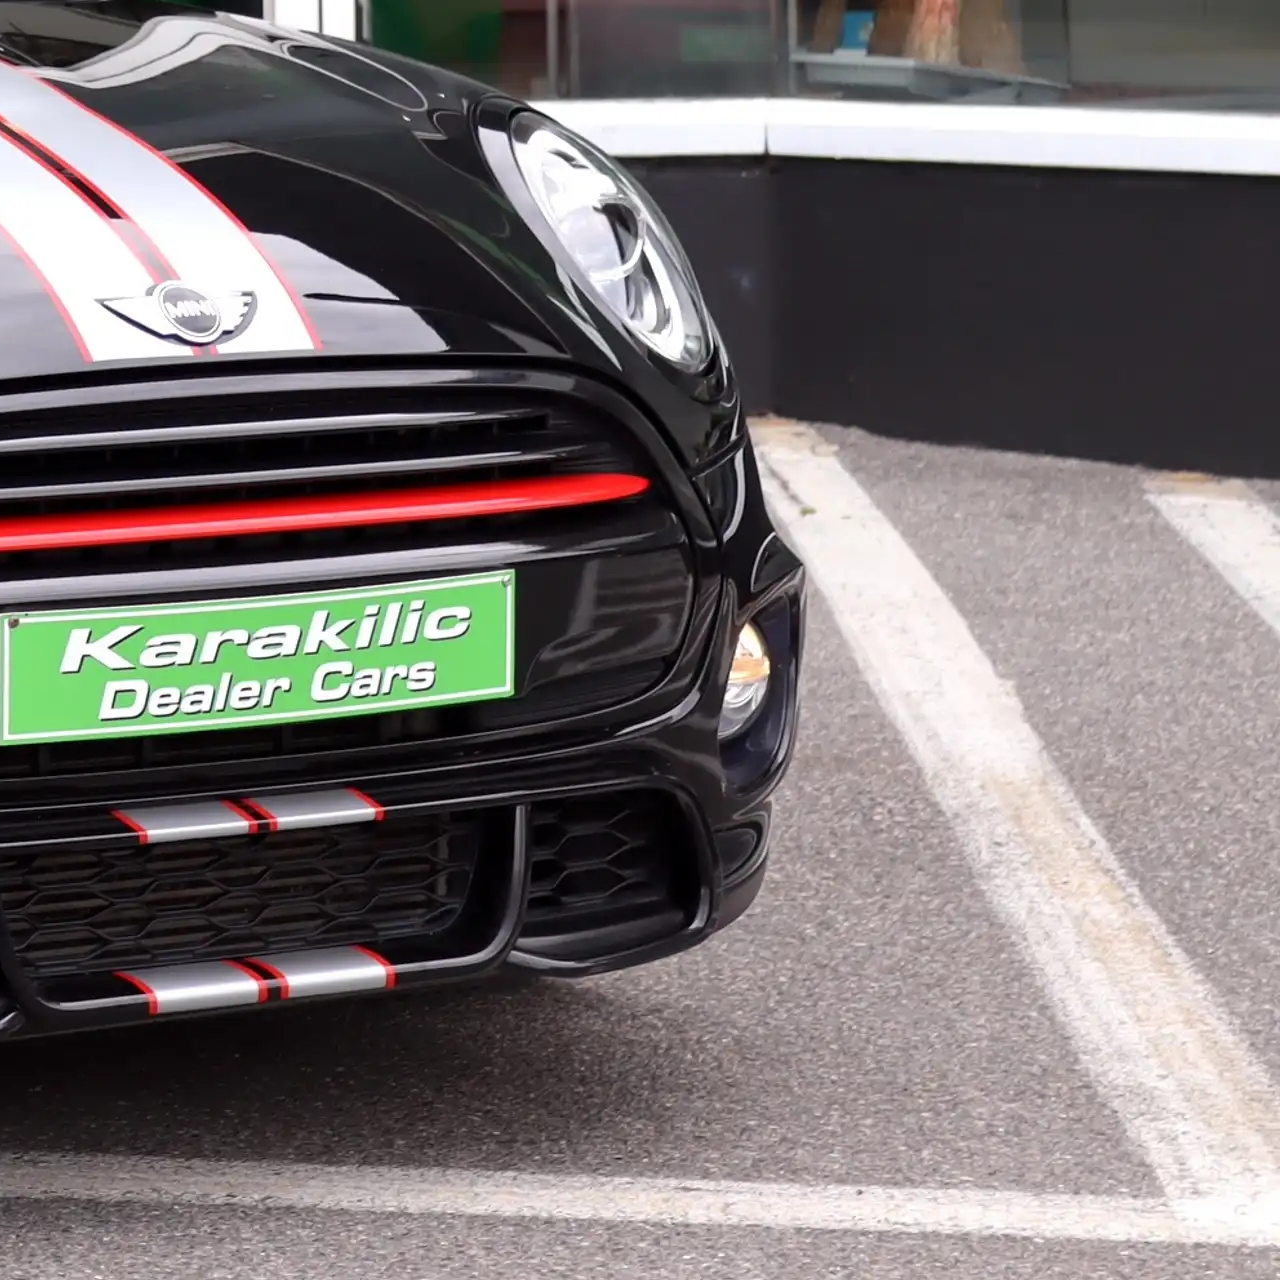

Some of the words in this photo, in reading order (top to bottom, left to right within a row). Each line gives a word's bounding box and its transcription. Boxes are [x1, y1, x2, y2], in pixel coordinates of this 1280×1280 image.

[164, 299, 218, 319] MINI
[59, 599, 472, 674] Karakilic
[98, 672, 291, 721] Dealer
[310, 659, 437, 702] Cars
